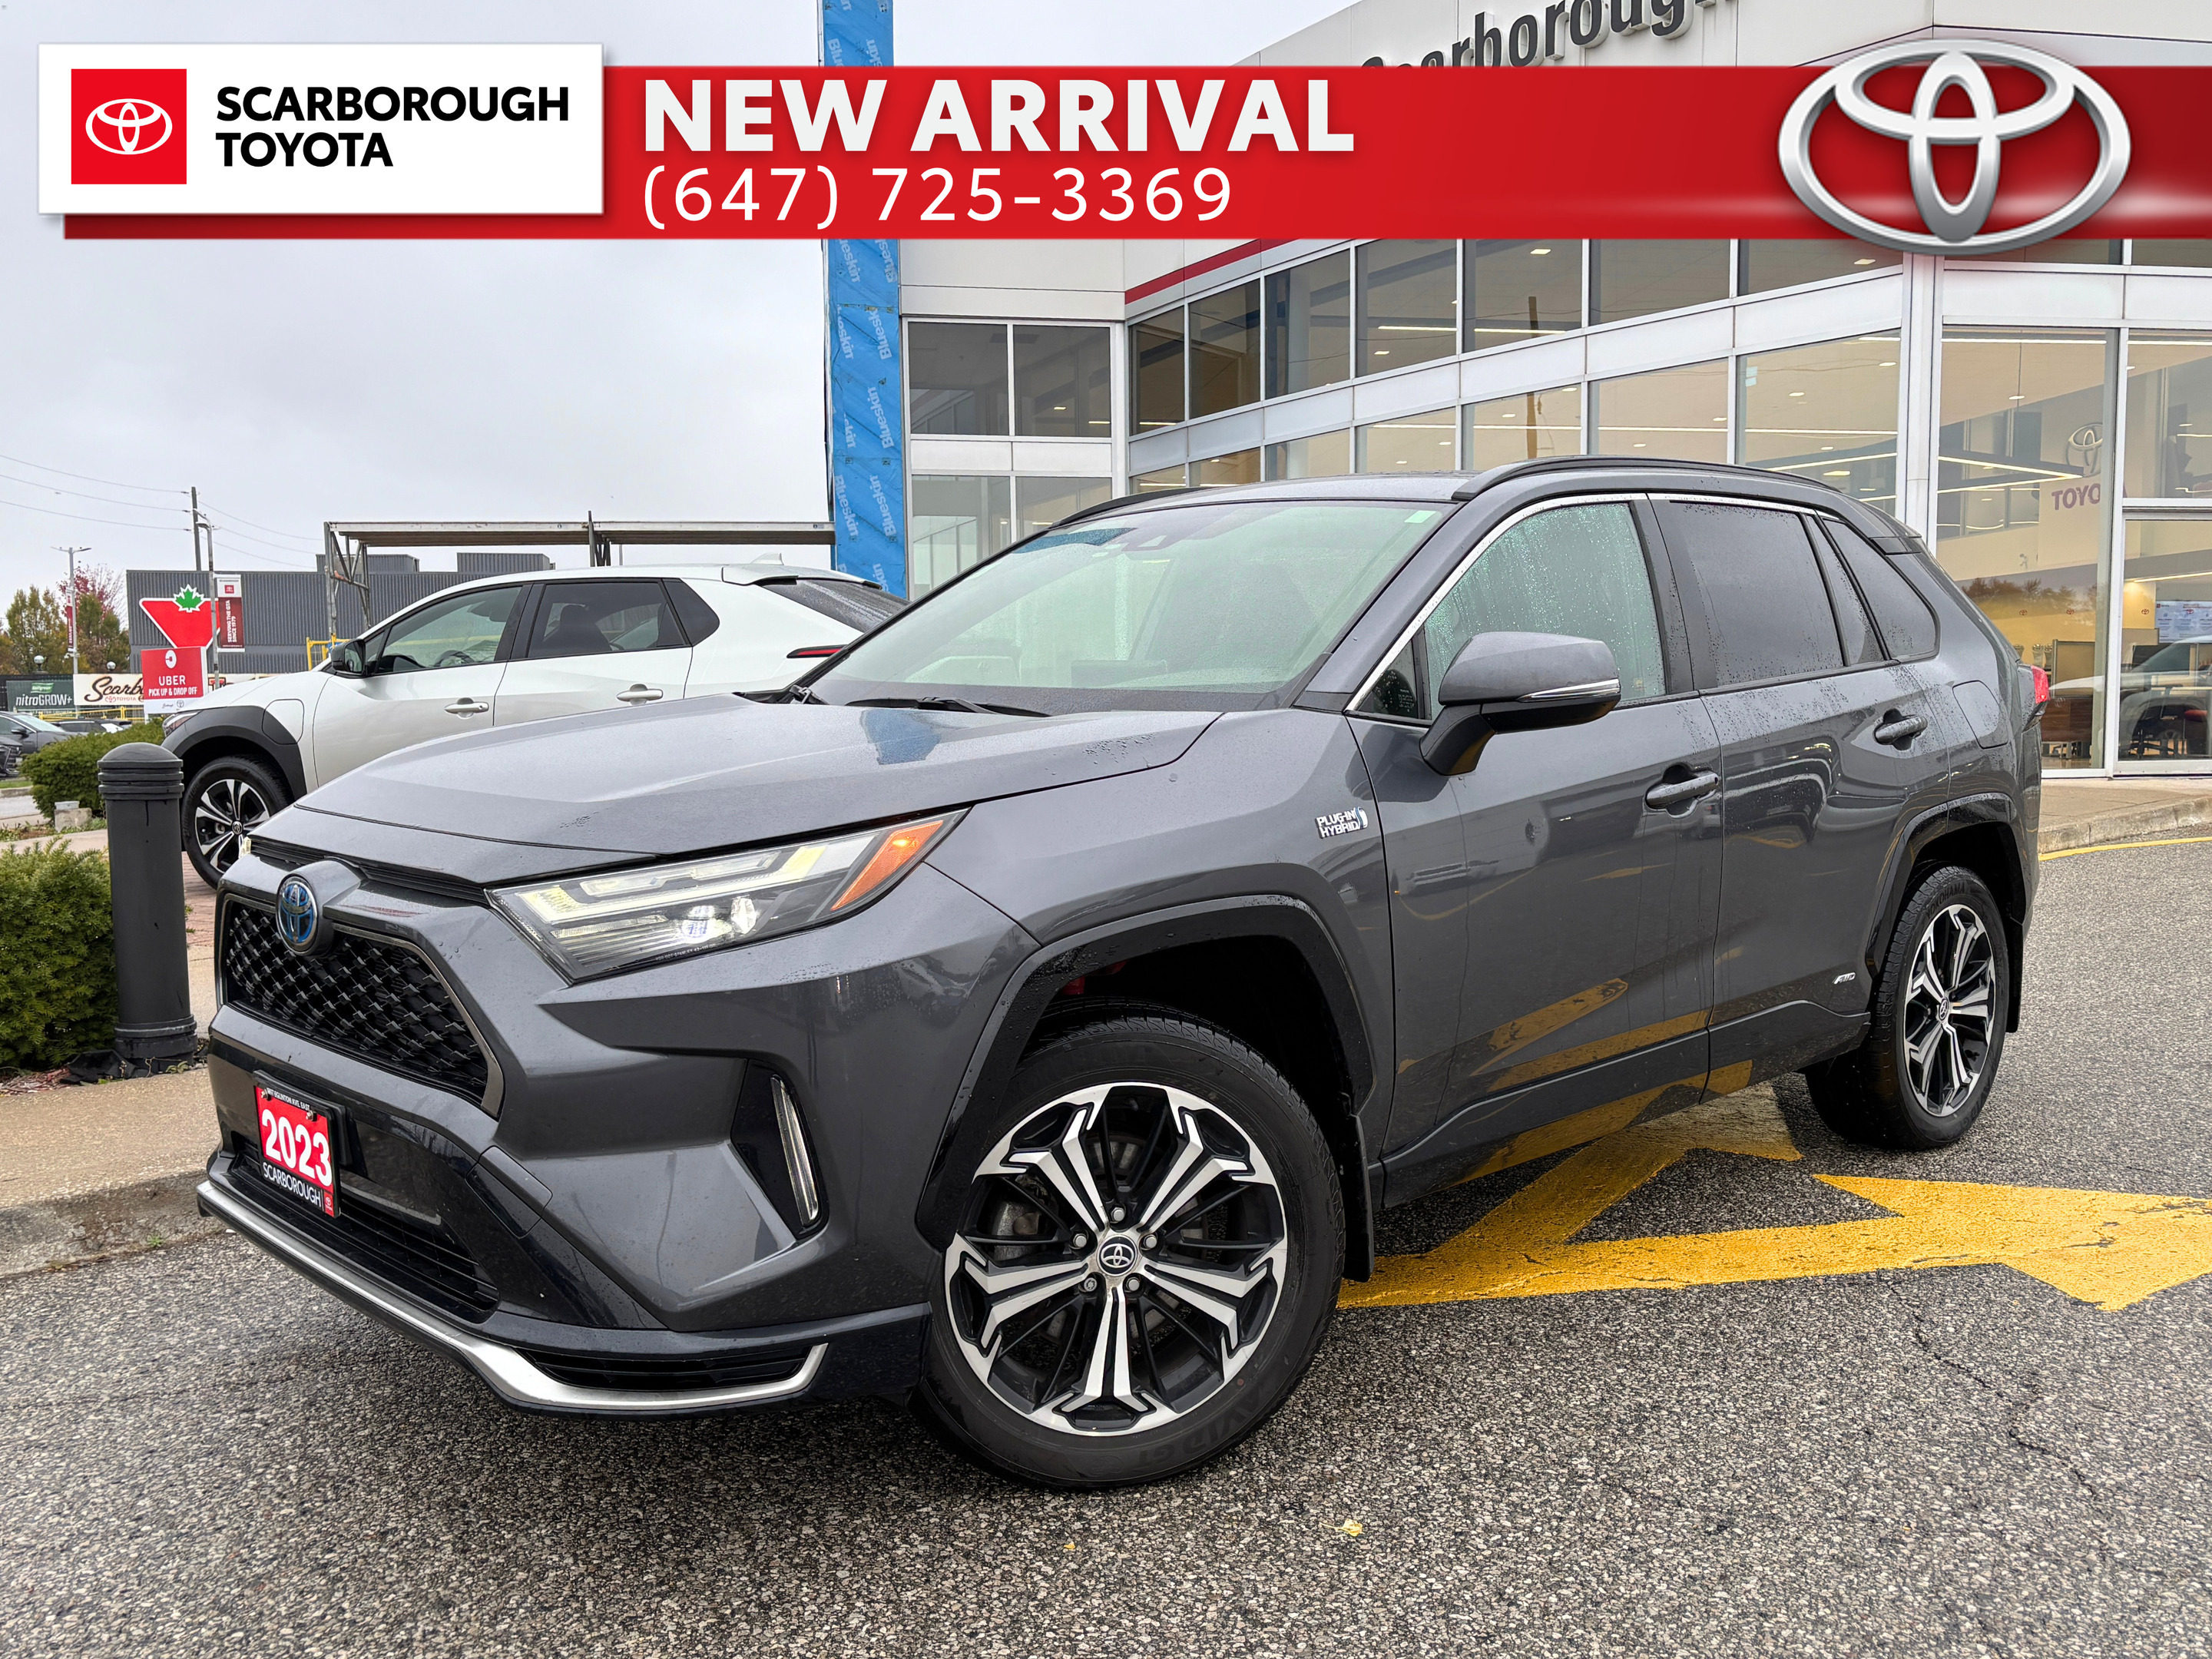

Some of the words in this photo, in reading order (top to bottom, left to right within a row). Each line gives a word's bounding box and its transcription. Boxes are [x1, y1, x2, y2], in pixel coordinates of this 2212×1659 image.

[867, 386, 895, 449] Blueskin
[835, 475, 859, 536] Blueskin
[869, 474, 897, 537] Blueskin
[2051, 483, 2101, 510] TOYO
[148, 688, 161, 697] PICK
[161, 687, 167, 696] UP
[174, 687, 187, 695] DROP
[158, 674, 186, 686] UBER
[1316, 807, 1356, 827] PLUG-IN
[1319, 821, 1361, 838] HYBRID
[261, 1108, 333, 1187] 2023
[263, 1161, 322, 1208] SCARBOROUGH
